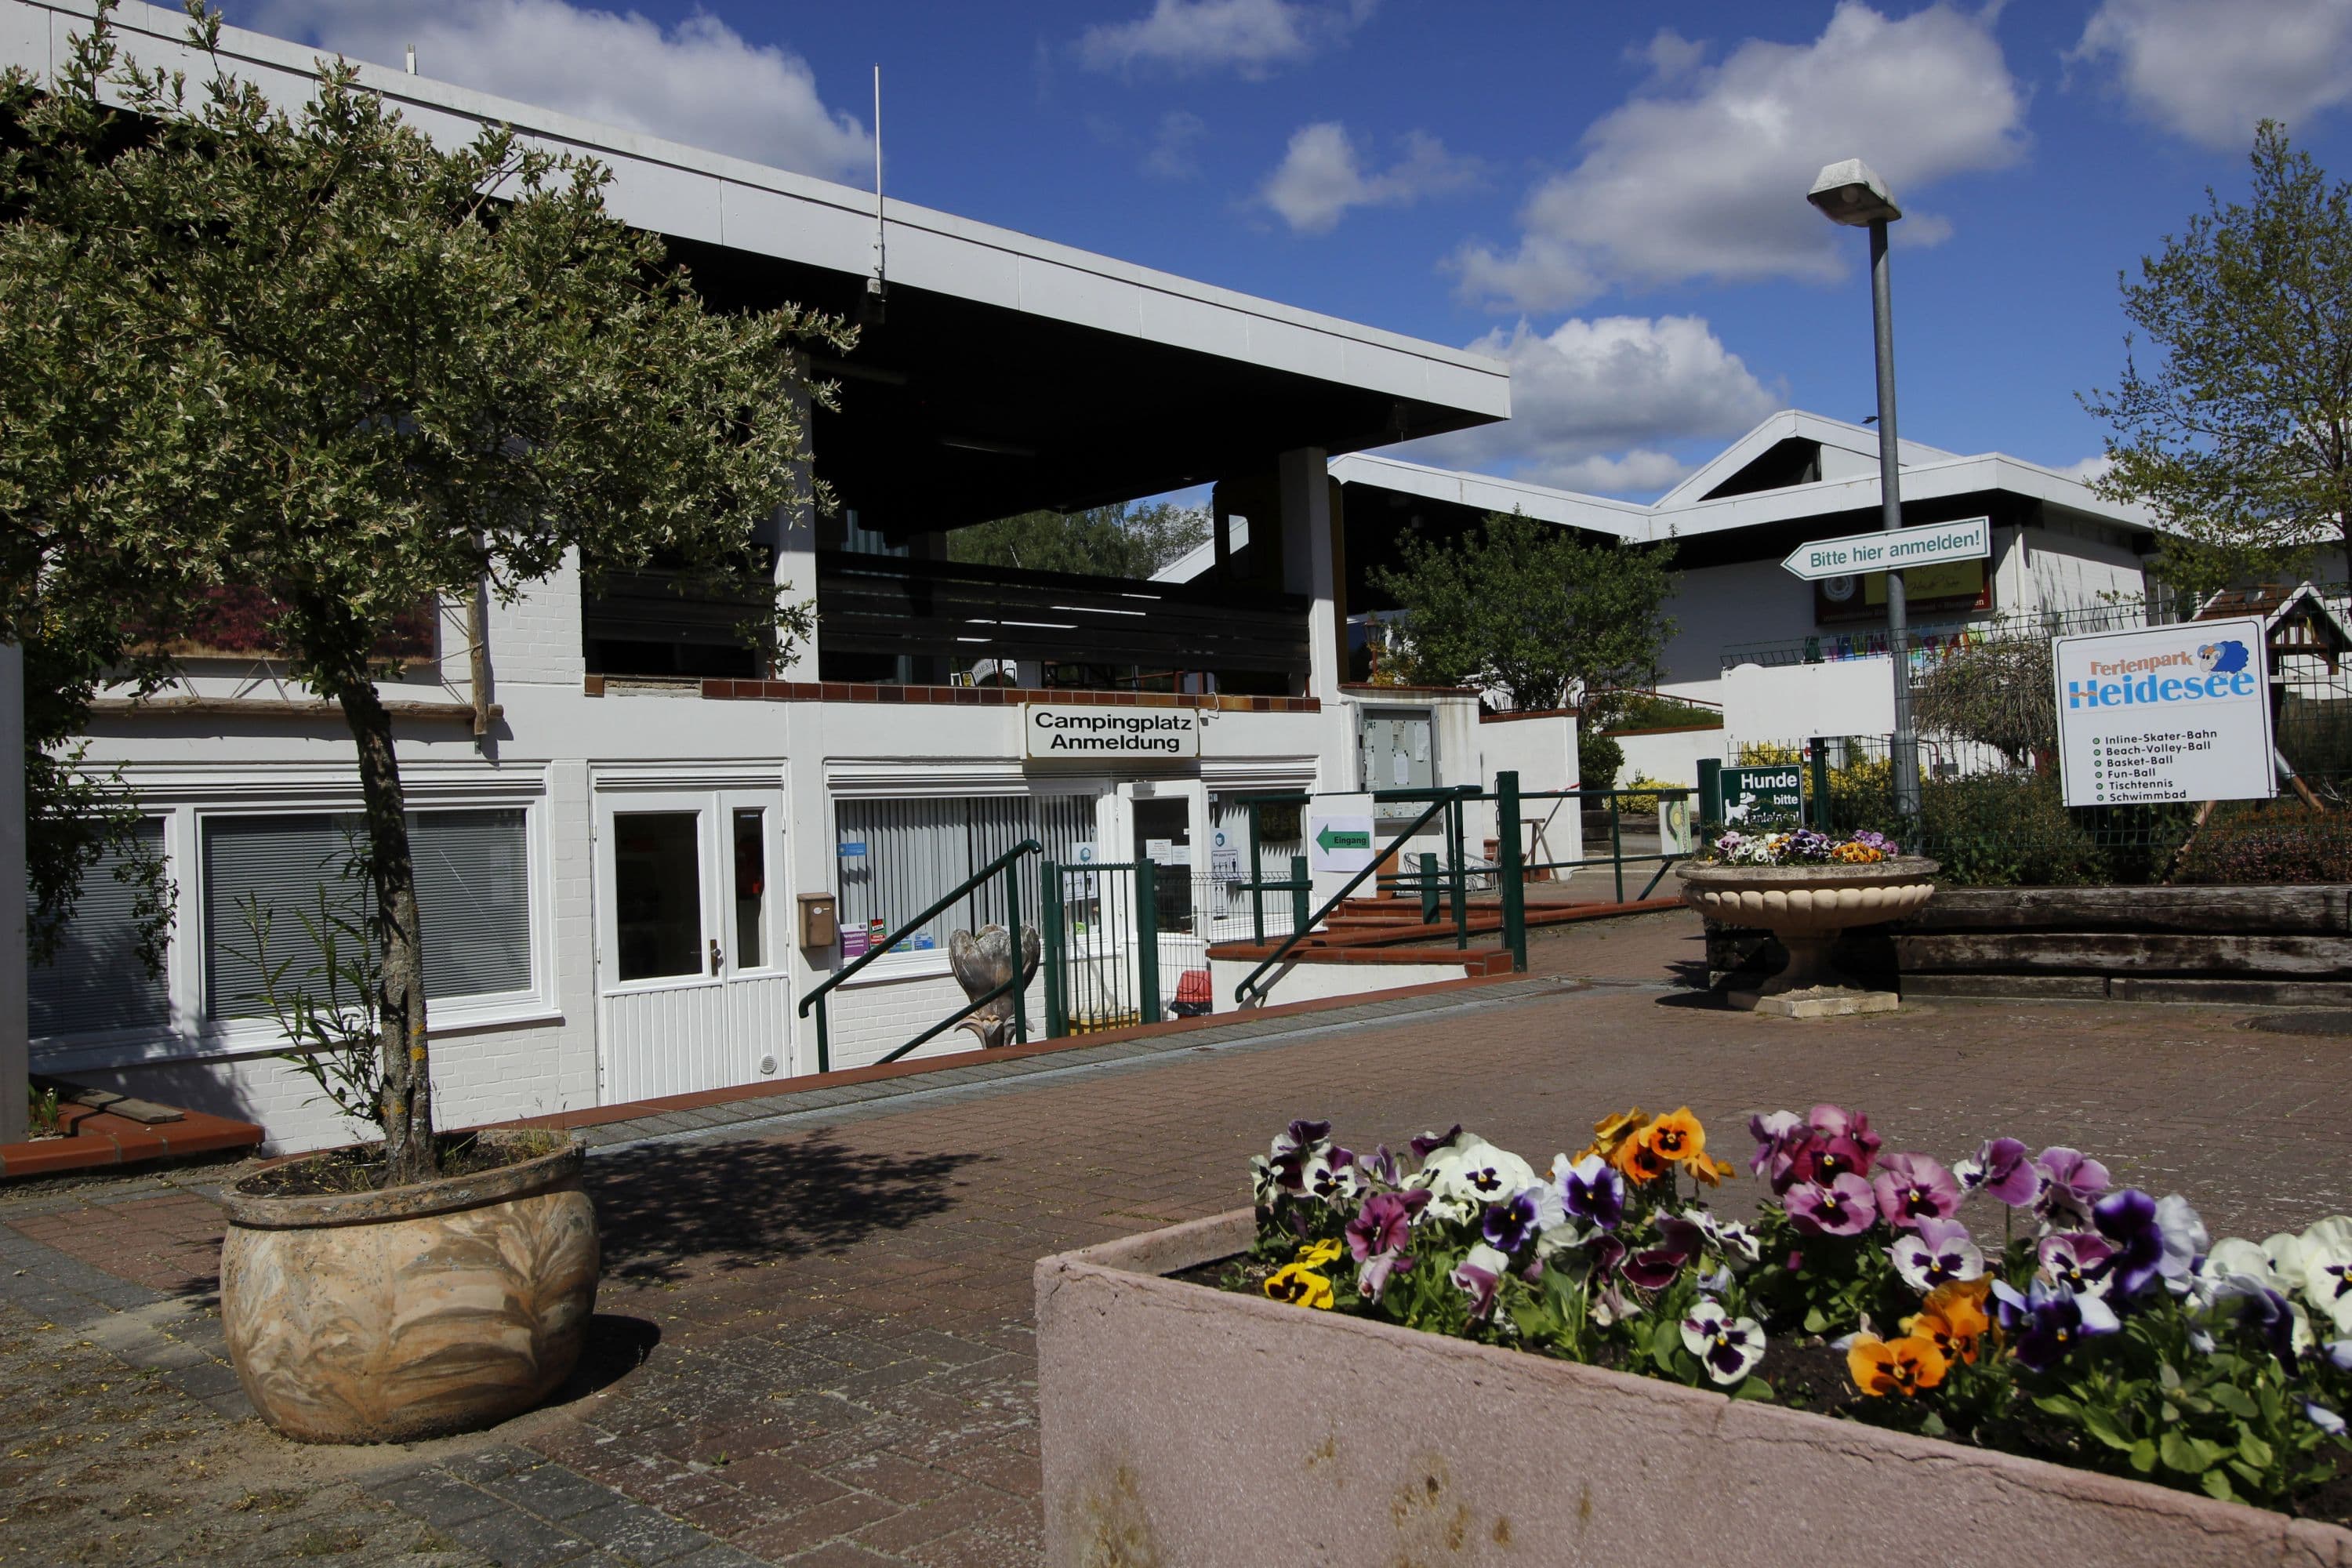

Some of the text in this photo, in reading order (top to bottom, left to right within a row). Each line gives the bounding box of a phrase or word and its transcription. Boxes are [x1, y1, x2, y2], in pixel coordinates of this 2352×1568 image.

[1809, 529, 1980, 568] Bitte hier anmelden!
[2089, 651, 2194, 676] Ferienpark
[2068, 672, 2255, 709] Heidesee
[1035, 712, 1192, 733] Campingplatz
[1050, 734, 1180, 753] Anmeldung
[2105, 729, 2218, 745] Inline-Skater-Bahn
[2106, 741, 2211, 757] Beach-Volley-Ball
[2107, 755, 2173, 768] Basket-Ball
[1740, 771, 1798, 789] Hunde
[2107, 768, 2156, 779] Fun-Ball
[2109, 779, 2173, 790] Tischtennis
[1773, 793, 1798, 805] bitte
[2109, 789, 2187, 802] Schwimmbad
[1334, 836, 1367, 846] Eingang
